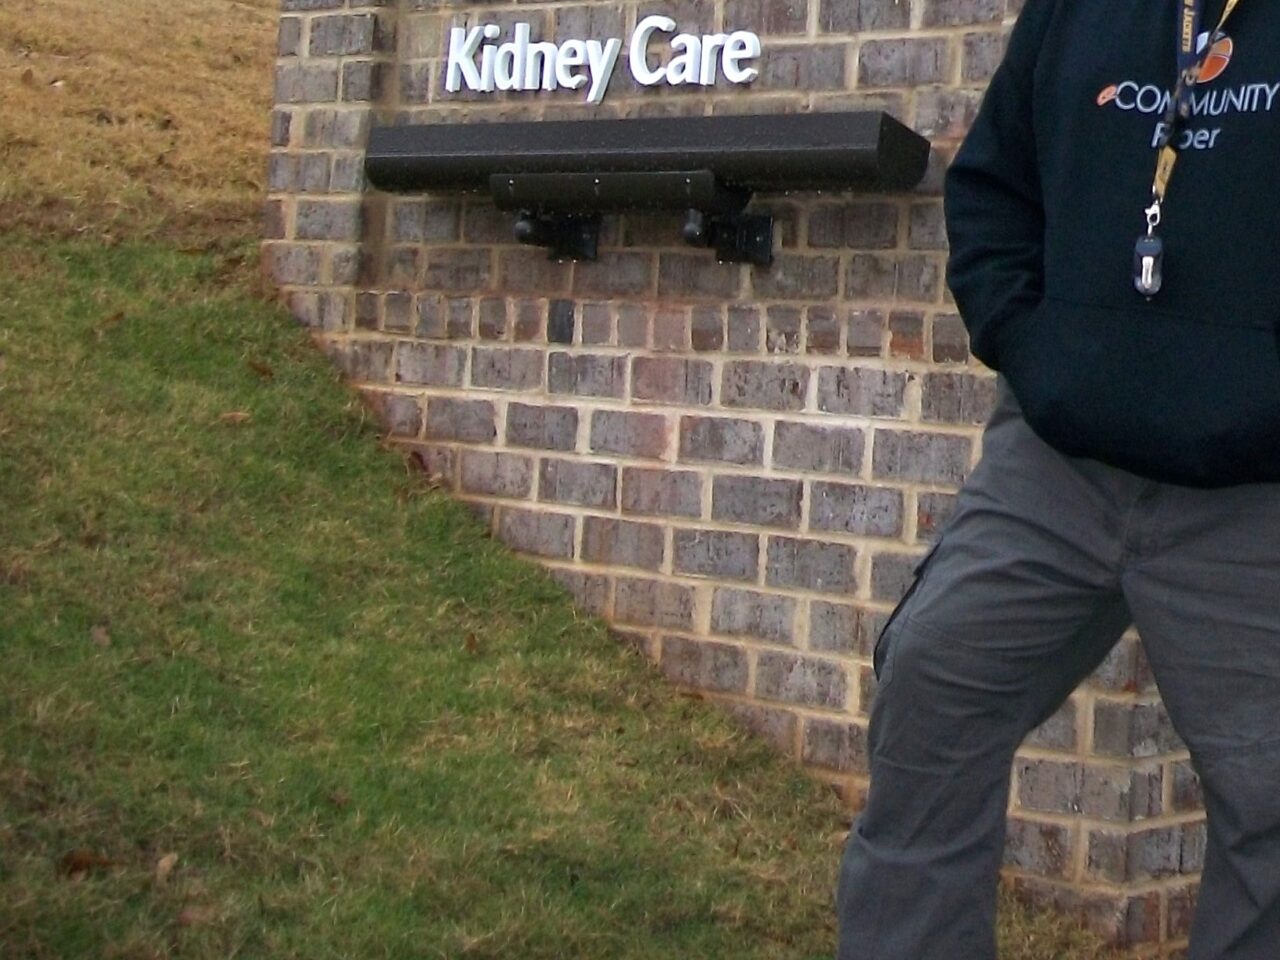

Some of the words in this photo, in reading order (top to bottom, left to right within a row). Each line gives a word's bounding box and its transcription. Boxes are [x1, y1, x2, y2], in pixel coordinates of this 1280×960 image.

[445, 22, 622, 103] Kidney
[629, 14, 761, 86] Care
[1151, 122, 1221, 149] Fer
